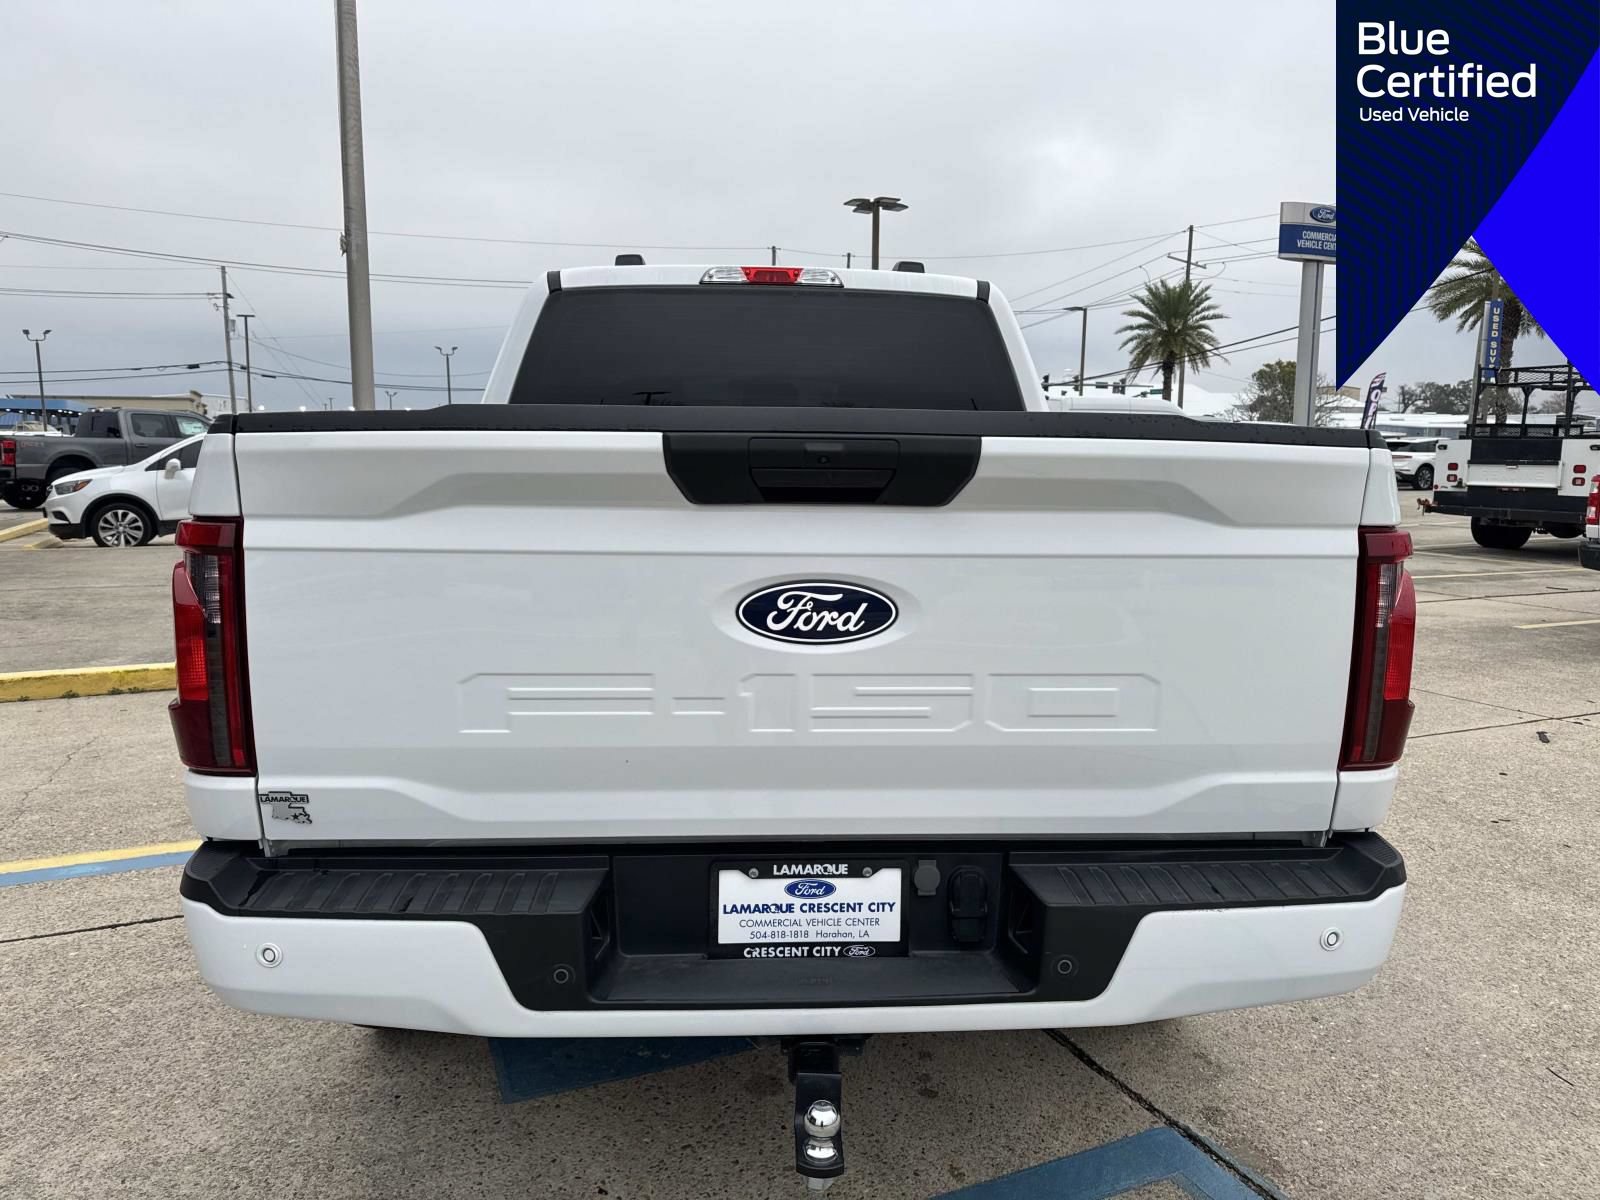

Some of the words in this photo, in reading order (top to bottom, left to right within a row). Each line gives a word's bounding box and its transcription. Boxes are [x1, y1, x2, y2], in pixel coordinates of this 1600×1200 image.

[1296, 240, 1323, 249] VEHICLE
[1491, 307, 1500, 338] USED
[766, 590, 869, 632] Ford
[457, 672, 1162, 734] F-150
[773, 863, 849, 876] LAMARQUE
[794, 882, 826, 896] Ford
[722, 903, 795, 915] LAMARQUE
[799, 902, 864, 914] CRESCENT
[867, 901, 896, 913] CITY
[739, 919, 802, 928] COMMERCIAL
[805, 918, 842, 927] VEHICLE
[844, 917, 880, 927] CENTER
[749, 930, 809, 940] 504-818-1818
[815, 929, 856, 939] Harahan,
[858, 929, 870, 938] LA
[743, 946, 809, 959] CRESCENT
[812, 946, 841, 958] CITY
